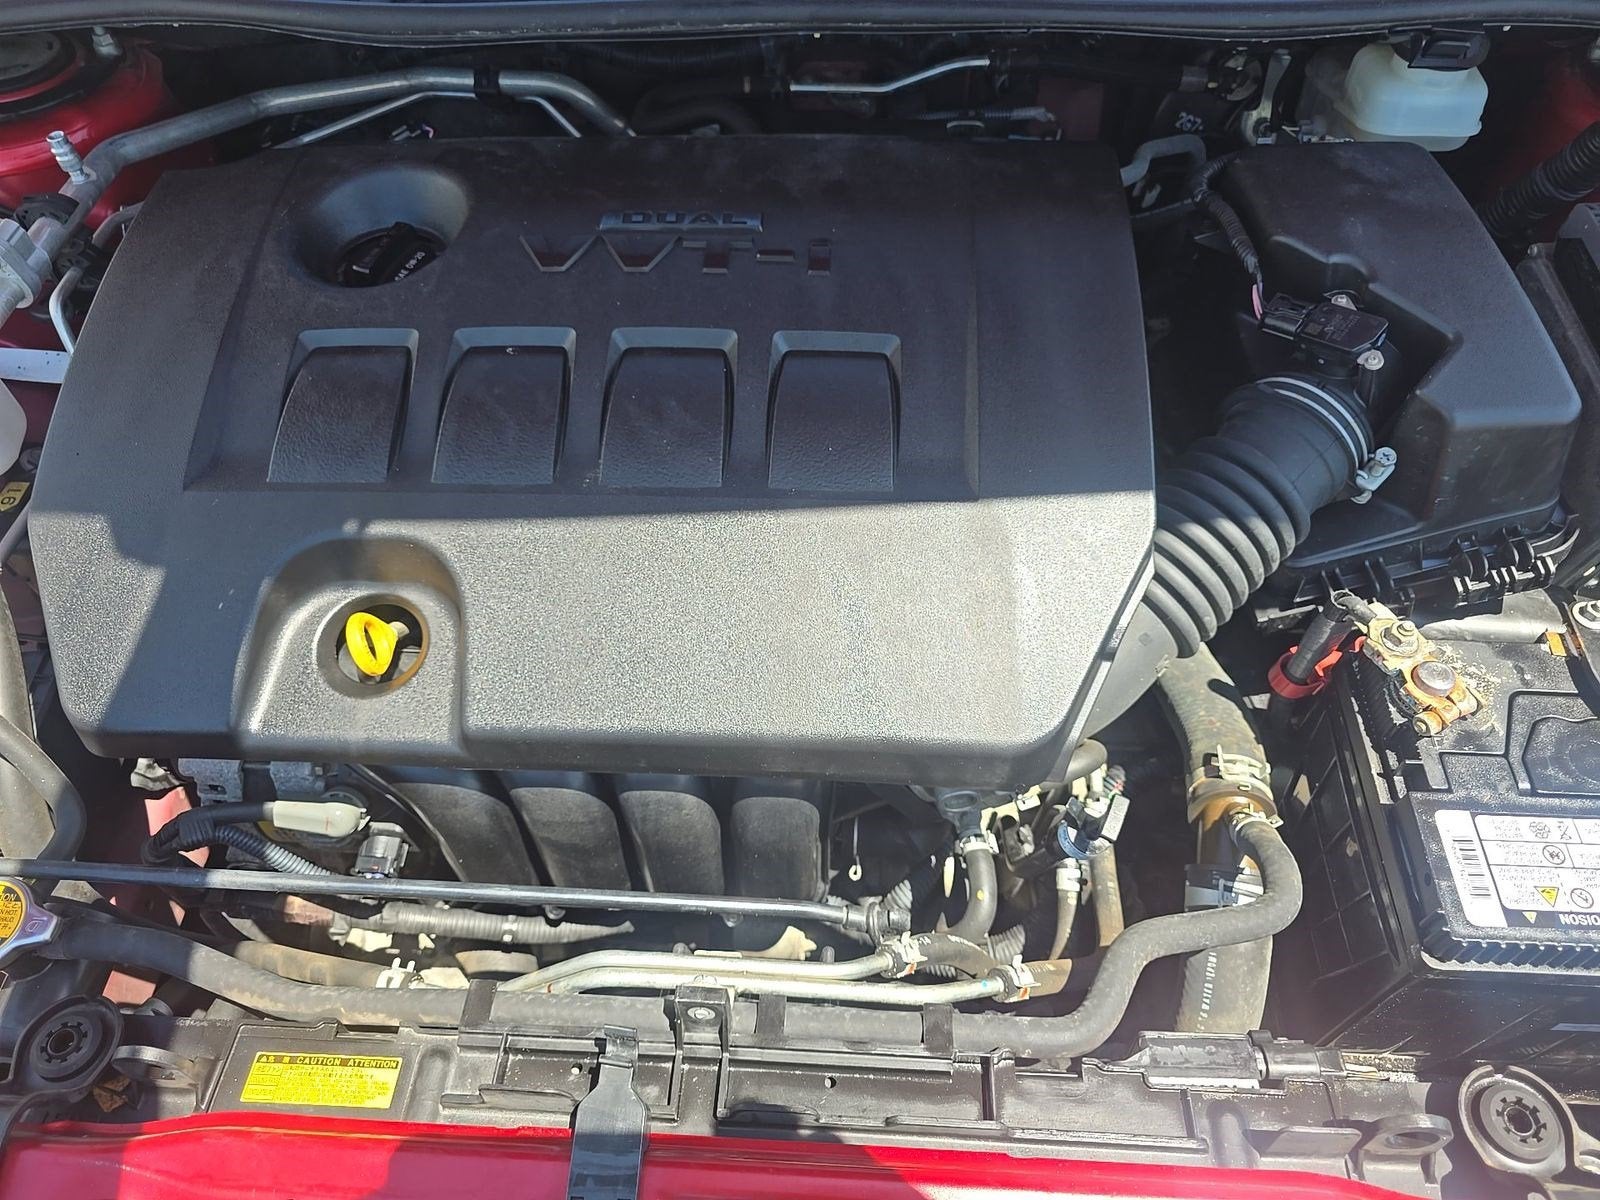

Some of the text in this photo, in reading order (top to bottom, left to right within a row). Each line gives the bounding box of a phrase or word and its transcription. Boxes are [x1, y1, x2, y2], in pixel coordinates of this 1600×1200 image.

[618, 210, 752, 227] DUAL
[296, 1056, 341, 1066] CAUTION
[347, 1058, 398, 1069] ATTENTION
